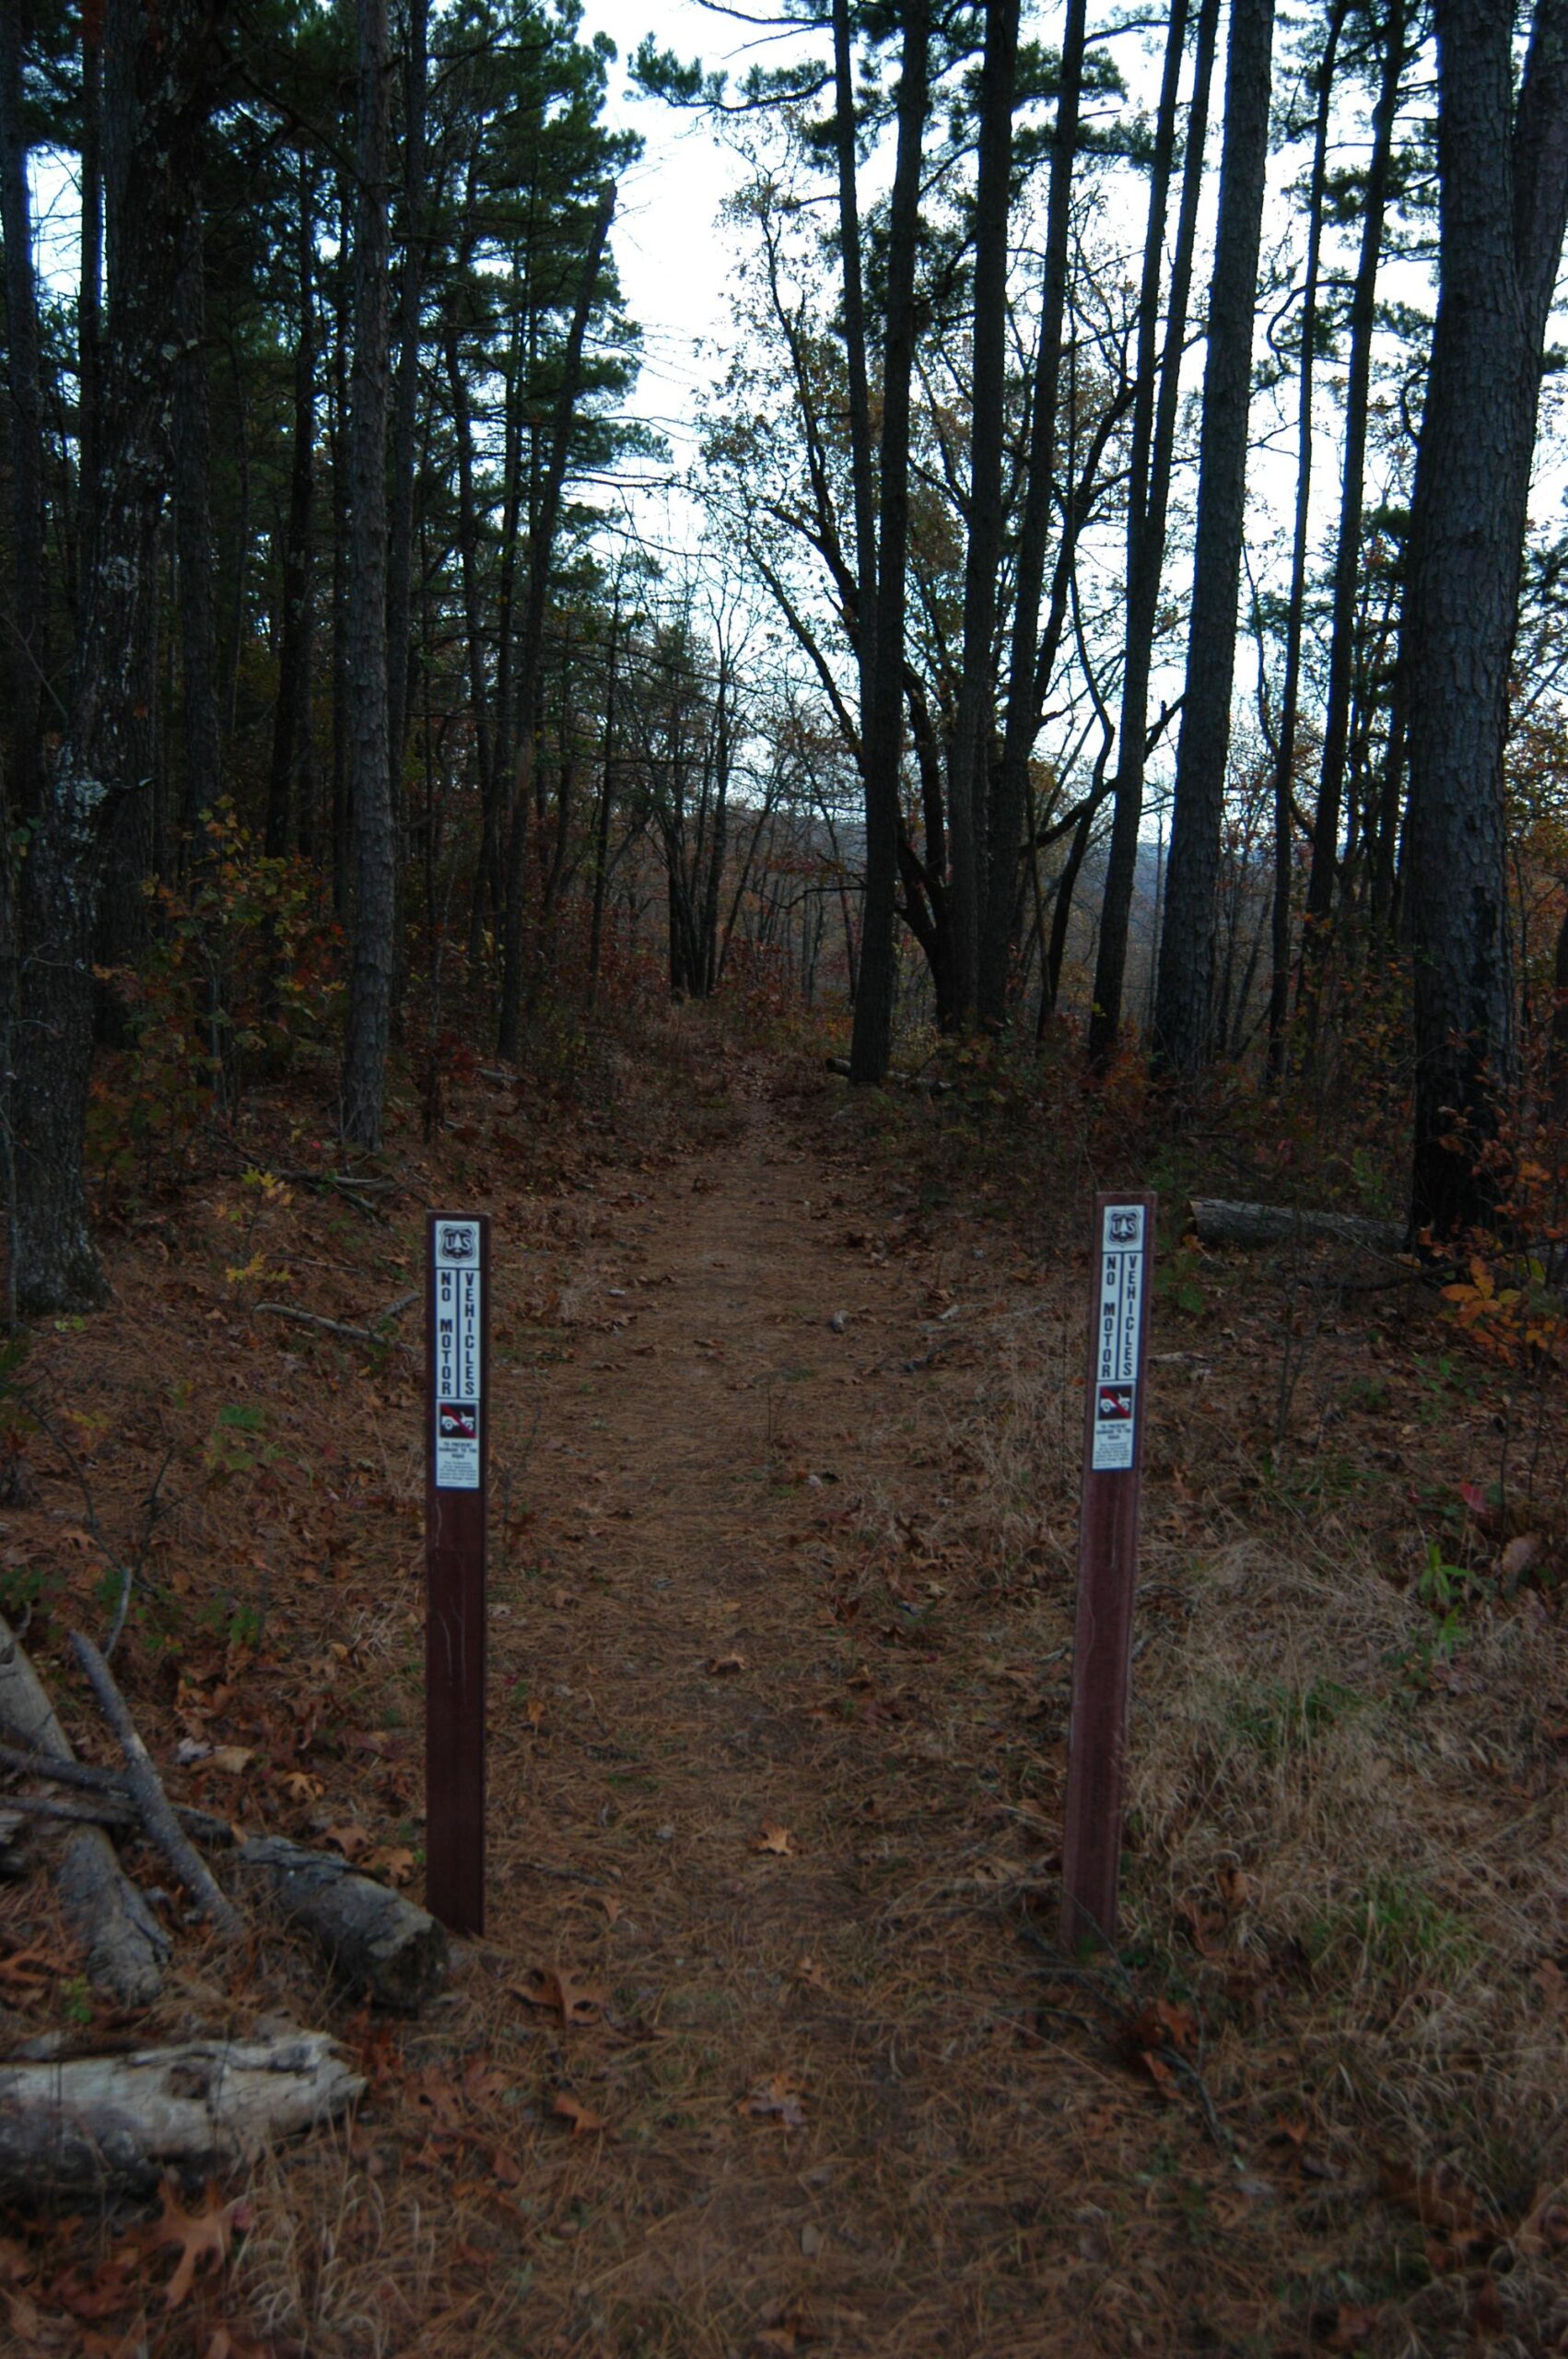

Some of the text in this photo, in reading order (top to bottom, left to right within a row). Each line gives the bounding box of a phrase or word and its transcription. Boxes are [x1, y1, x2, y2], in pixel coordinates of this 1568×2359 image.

[440, 1272, 452, 1395] NO MOTOR
[464, 1273, 475, 1396] VEHICLES
[1101, 1255, 1116, 1378] NO MOTOR
[1123, 1255, 1137, 1376] VEHICLES
